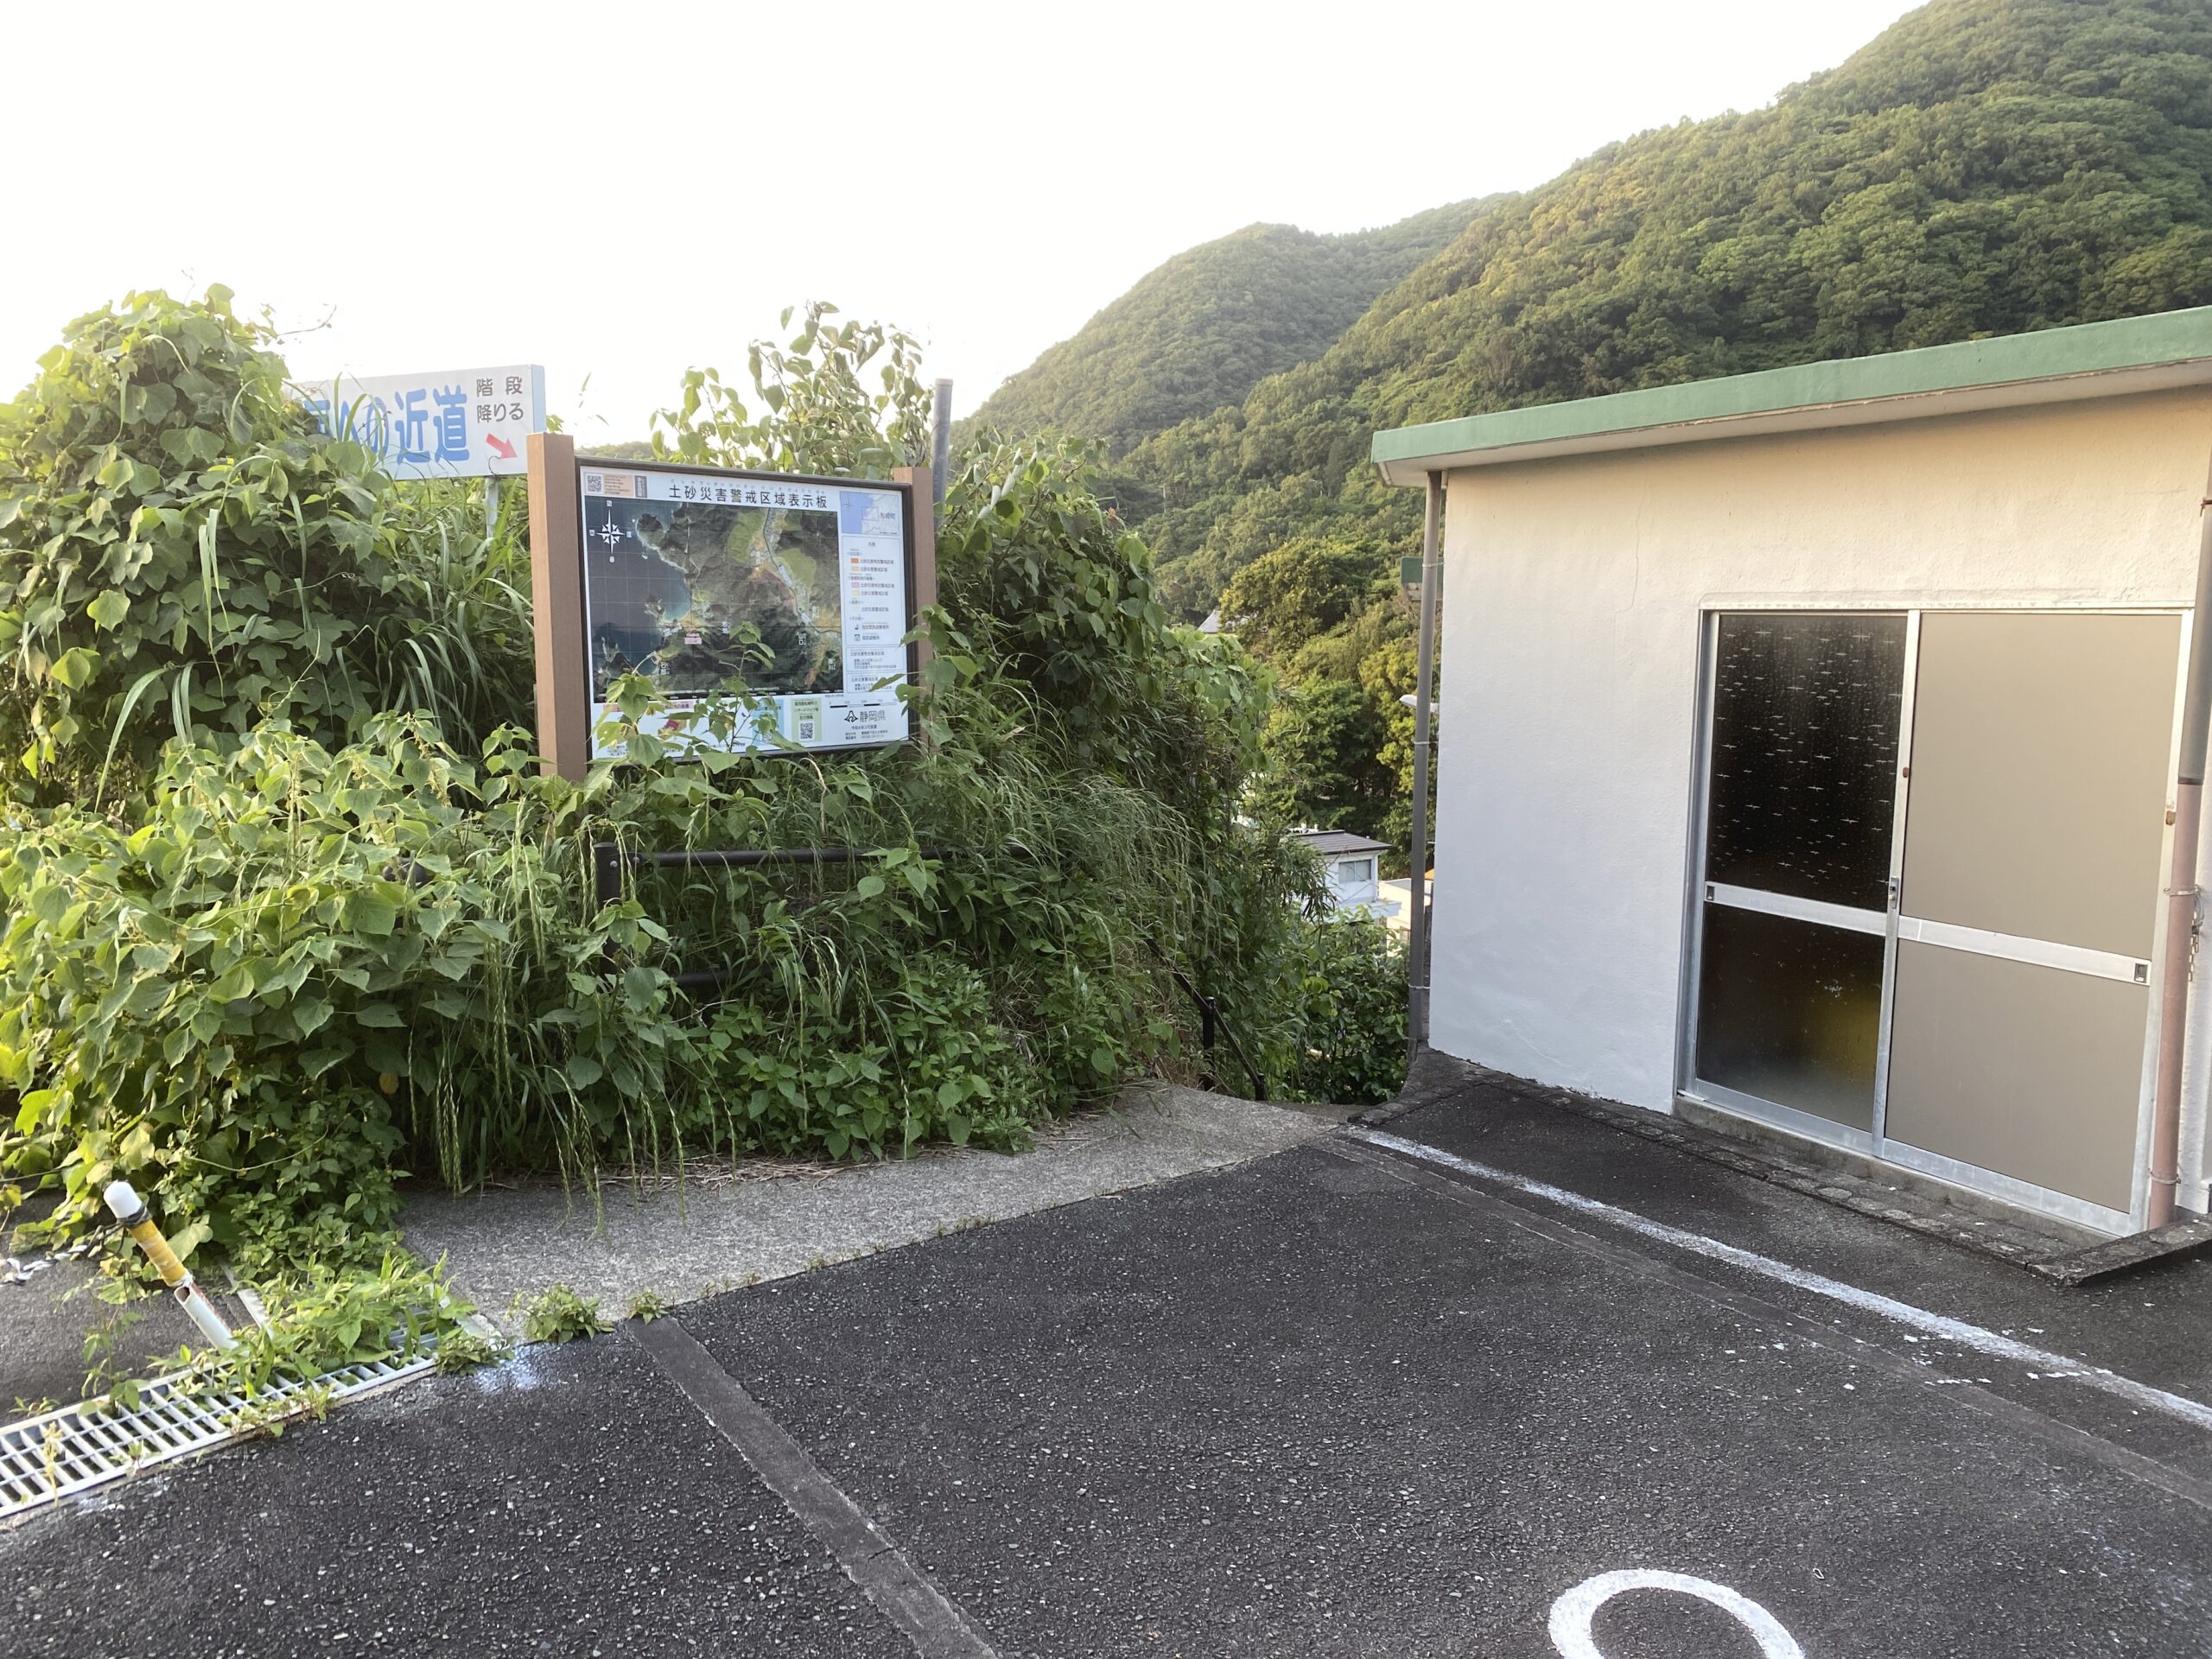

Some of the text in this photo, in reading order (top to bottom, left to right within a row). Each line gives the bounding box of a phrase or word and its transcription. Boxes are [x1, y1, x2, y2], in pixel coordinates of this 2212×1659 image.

[476, 376, 523, 397] 階段
[304, 385, 469, 464] への近道
[476, 403, 524, 423] 降りる
[669, 484, 827, 509] 土砂災害警戒区域表示板
